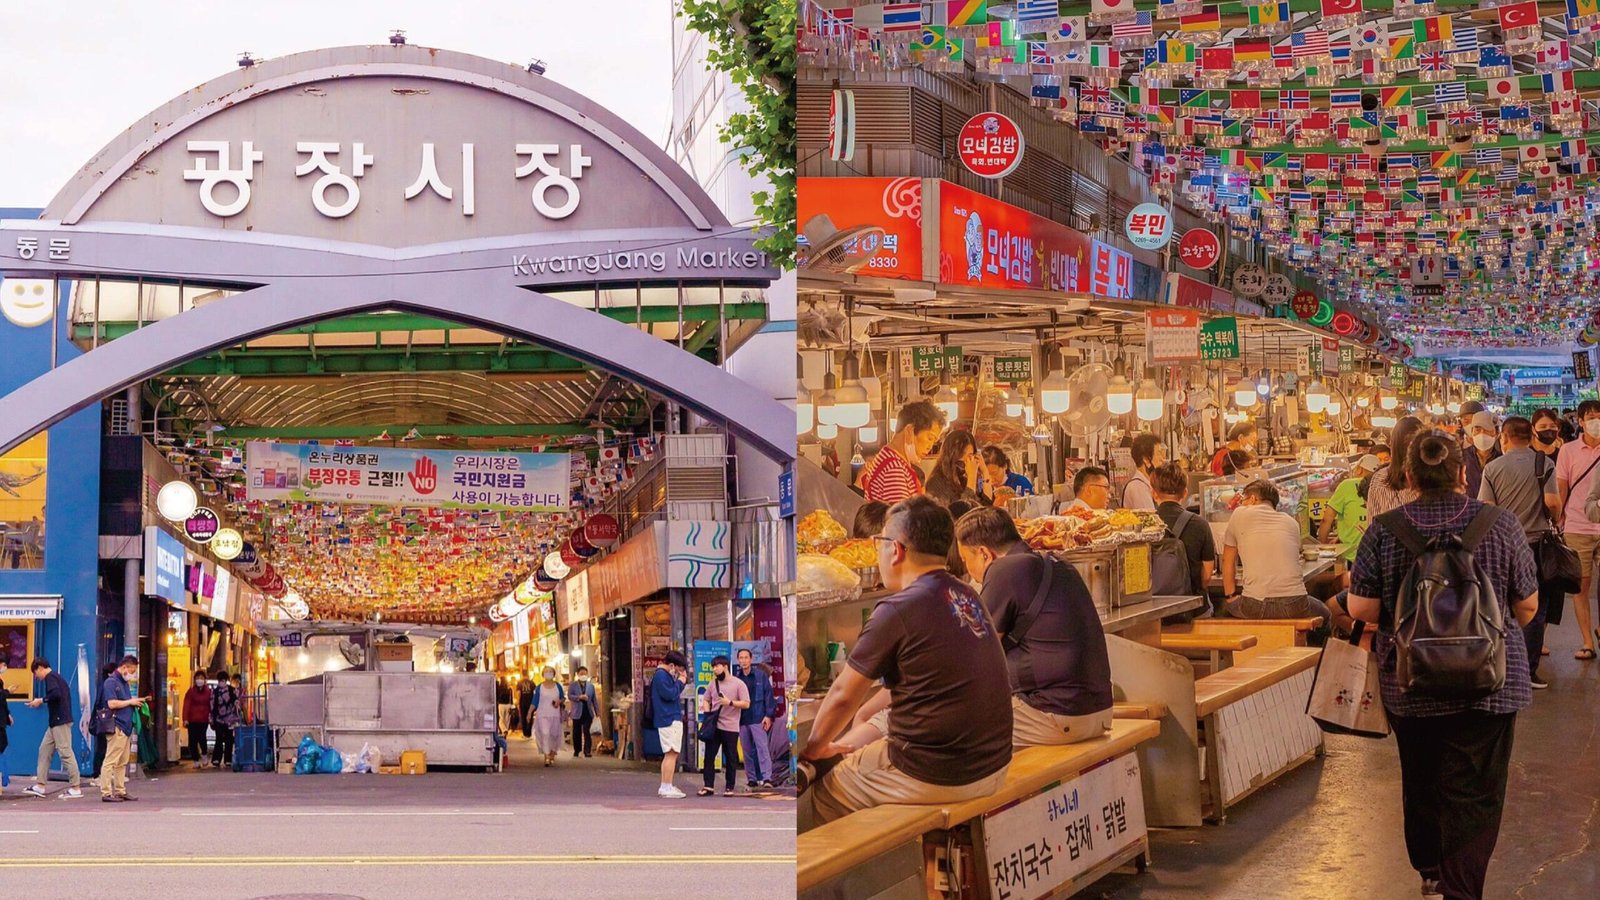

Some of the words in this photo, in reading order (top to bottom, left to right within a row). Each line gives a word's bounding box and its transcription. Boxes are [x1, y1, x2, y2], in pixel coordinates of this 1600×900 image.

[962, 136, 1016, 155] 모녀김밥
[183, 140, 592, 219] 광장시장
[1129, 213, 1166, 236] 복민
[17, 237, 70, 260] 동문
[677, 247, 767, 269] Market
[986, 229, 1033, 284] 모녀김밥
[1182, 244, 1215, 259] 고향집
[919, 355, 959, 371] 보리밥
[309, 451, 379, 466] 온누리상품권
[454, 456, 519, 471] 우리시장은
[309, 468, 361, 487] 부정유통
[368, 470, 405, 487] 근절!!
[415, 477, 435, 490] NO
[453, 472, 526, 489] 국민지원금
[452, 491, 491, 505] 사용이
[496, 492, 565, 507] 가능합니다.
[993, 837, 1054, 900] 잔치국수
[1065, 814, 1093, 862] 잡채
[1102, 796, 1127, 841] 닭발
